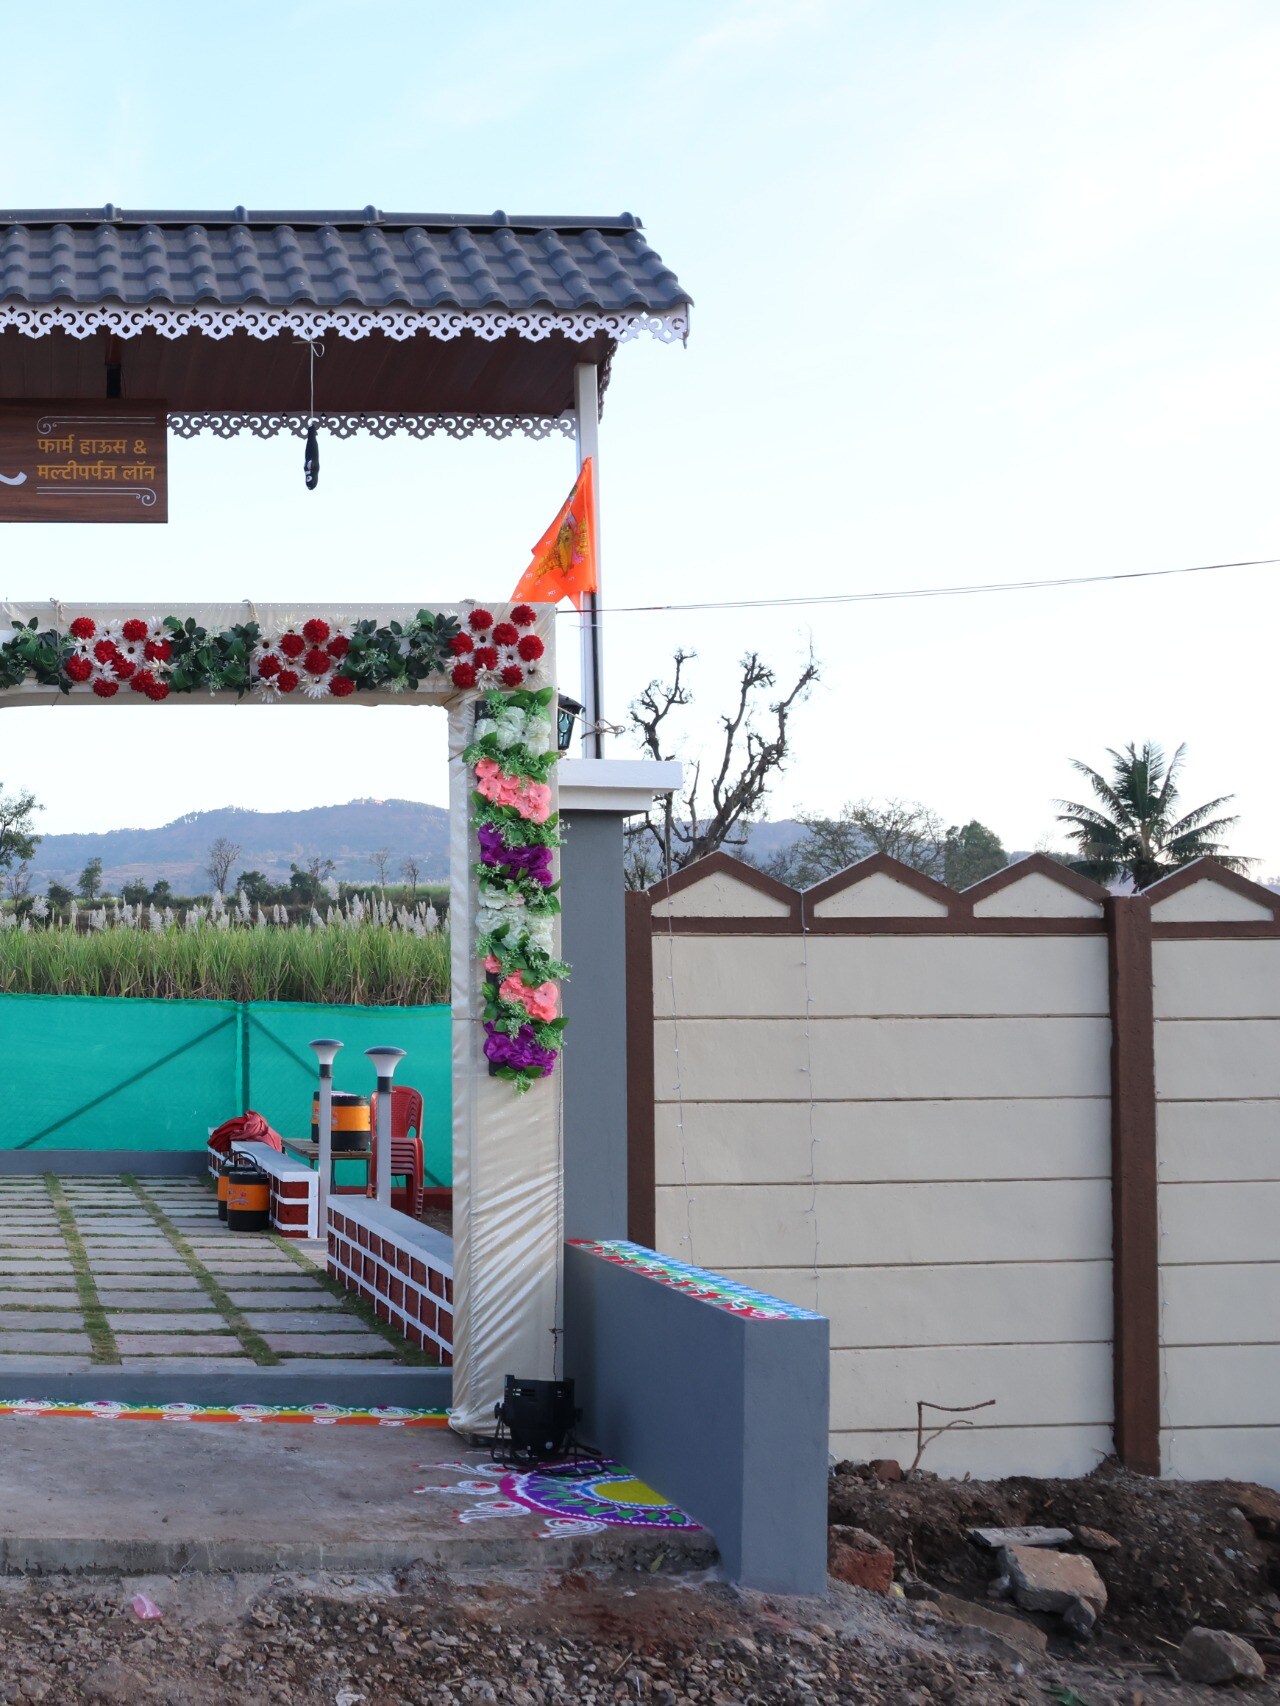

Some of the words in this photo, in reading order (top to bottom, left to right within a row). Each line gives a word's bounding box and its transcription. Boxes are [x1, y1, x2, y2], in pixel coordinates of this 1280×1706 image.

[37, 434, 75, 454] फार्म
[79, 439, 128, 455] हाऊस
[133, 439, 147, 454] &
[36, 460, 118, 480] मल्टीपर्पज
[121, 460, 156, 480] लॉन
